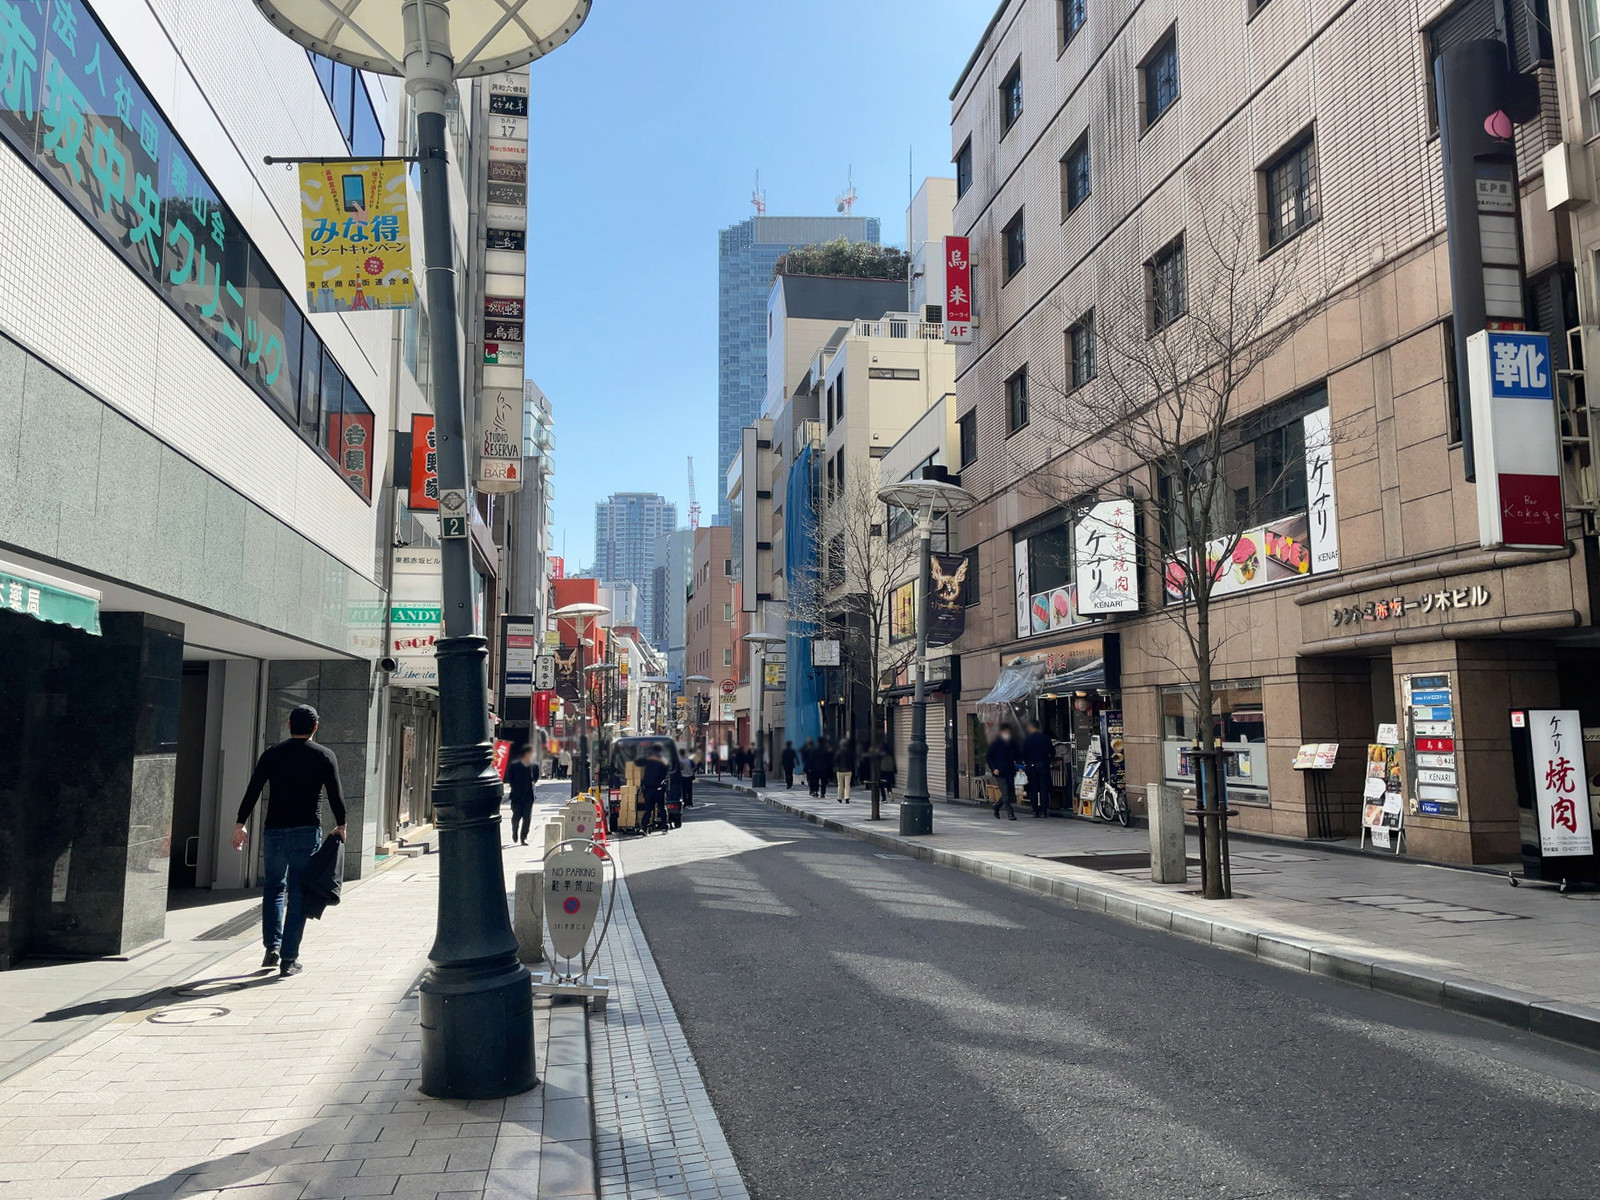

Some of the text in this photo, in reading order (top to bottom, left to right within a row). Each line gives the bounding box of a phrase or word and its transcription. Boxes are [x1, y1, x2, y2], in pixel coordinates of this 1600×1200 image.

[501, 126, 516, 137] 17
[310, 215, 400, 244] みな得
[310, 242, 406, 256] レシートキャンペーン
[950, 325, 967, 337] 4F
[1493, 342, 1547, 388] 靴
[484, 440, 519, 457] RESERVA
[484, 468, 506, 479] BAR
[450, 518, 459, 536] 2
[395, 556, 441, 565] 東都赤坂ビル
[1093, 600, 1123, 609] KENARI
[394, 611, 439, 621] ANDY
[1550, 715, 1561, 755] ケナリ
[1545, 756, 1577, 834] 焼肉
[552, 867, 596, 878] NO PARKING
[552, 880, 594, 892] 駐車禁止
